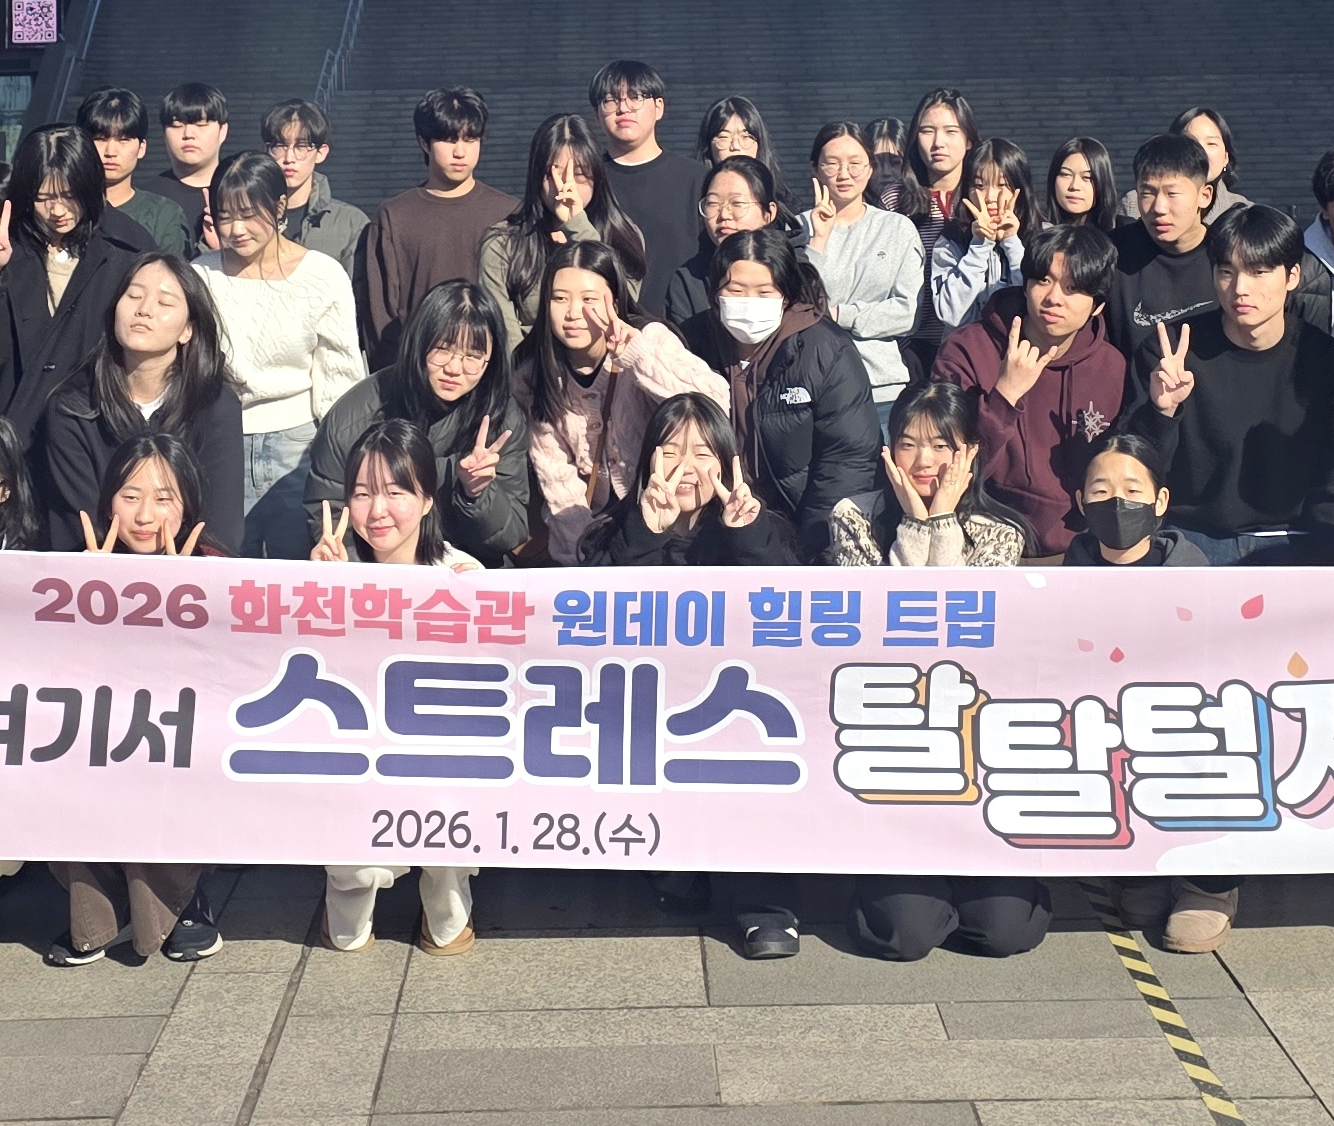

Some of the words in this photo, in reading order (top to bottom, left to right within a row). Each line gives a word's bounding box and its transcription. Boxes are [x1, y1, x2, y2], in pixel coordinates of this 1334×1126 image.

[32, 577, 209, 630] 2026
[228, 580, 535, 645] 화천학습관
[552, 588, 726, 647] 원데이
[748, 588, 863, 648] 힐링
[883, 590, 997, 648] 트립
[229, 648, 804, 786] 스트레스
[371, 809, 482, 854] 2026.
[496, 810, 520, 855] 1.
[532, 811, 661, 857] 28.(수)
